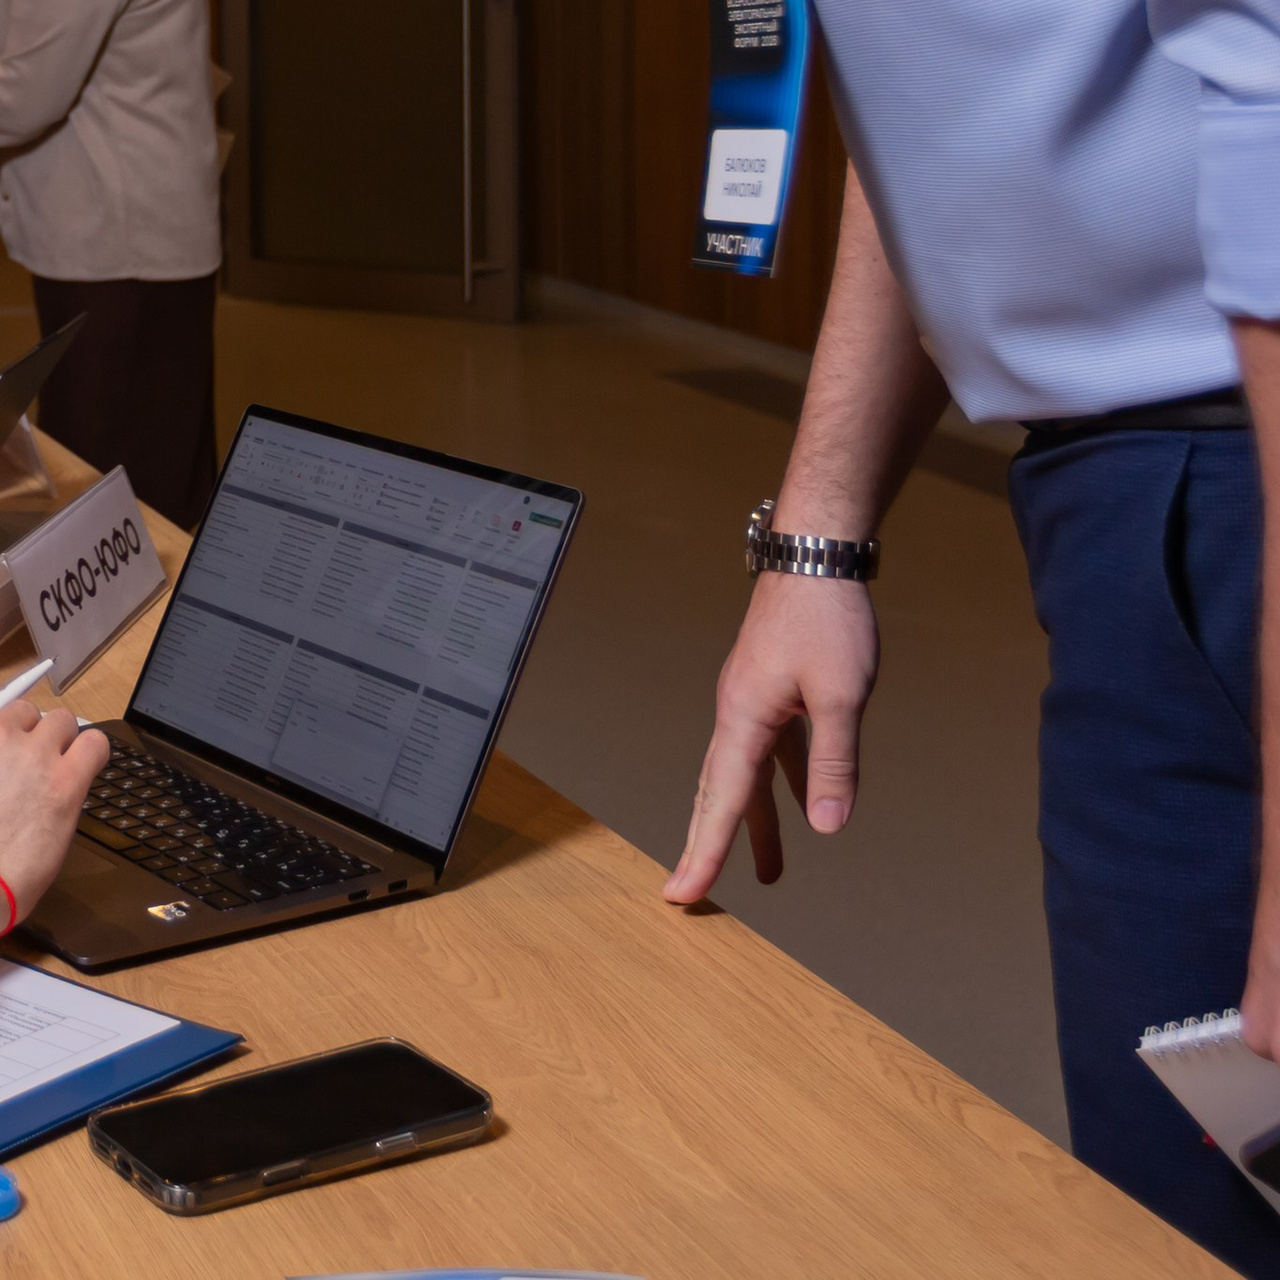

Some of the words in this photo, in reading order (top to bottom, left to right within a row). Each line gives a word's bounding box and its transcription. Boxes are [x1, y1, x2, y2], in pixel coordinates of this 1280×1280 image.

[722, 180, 762, 197] НИКОЛАЙ
[706, 233, 764, 257] УЧАСТНИК
[40, 518, 141, 632] СКФО-ЮФО
